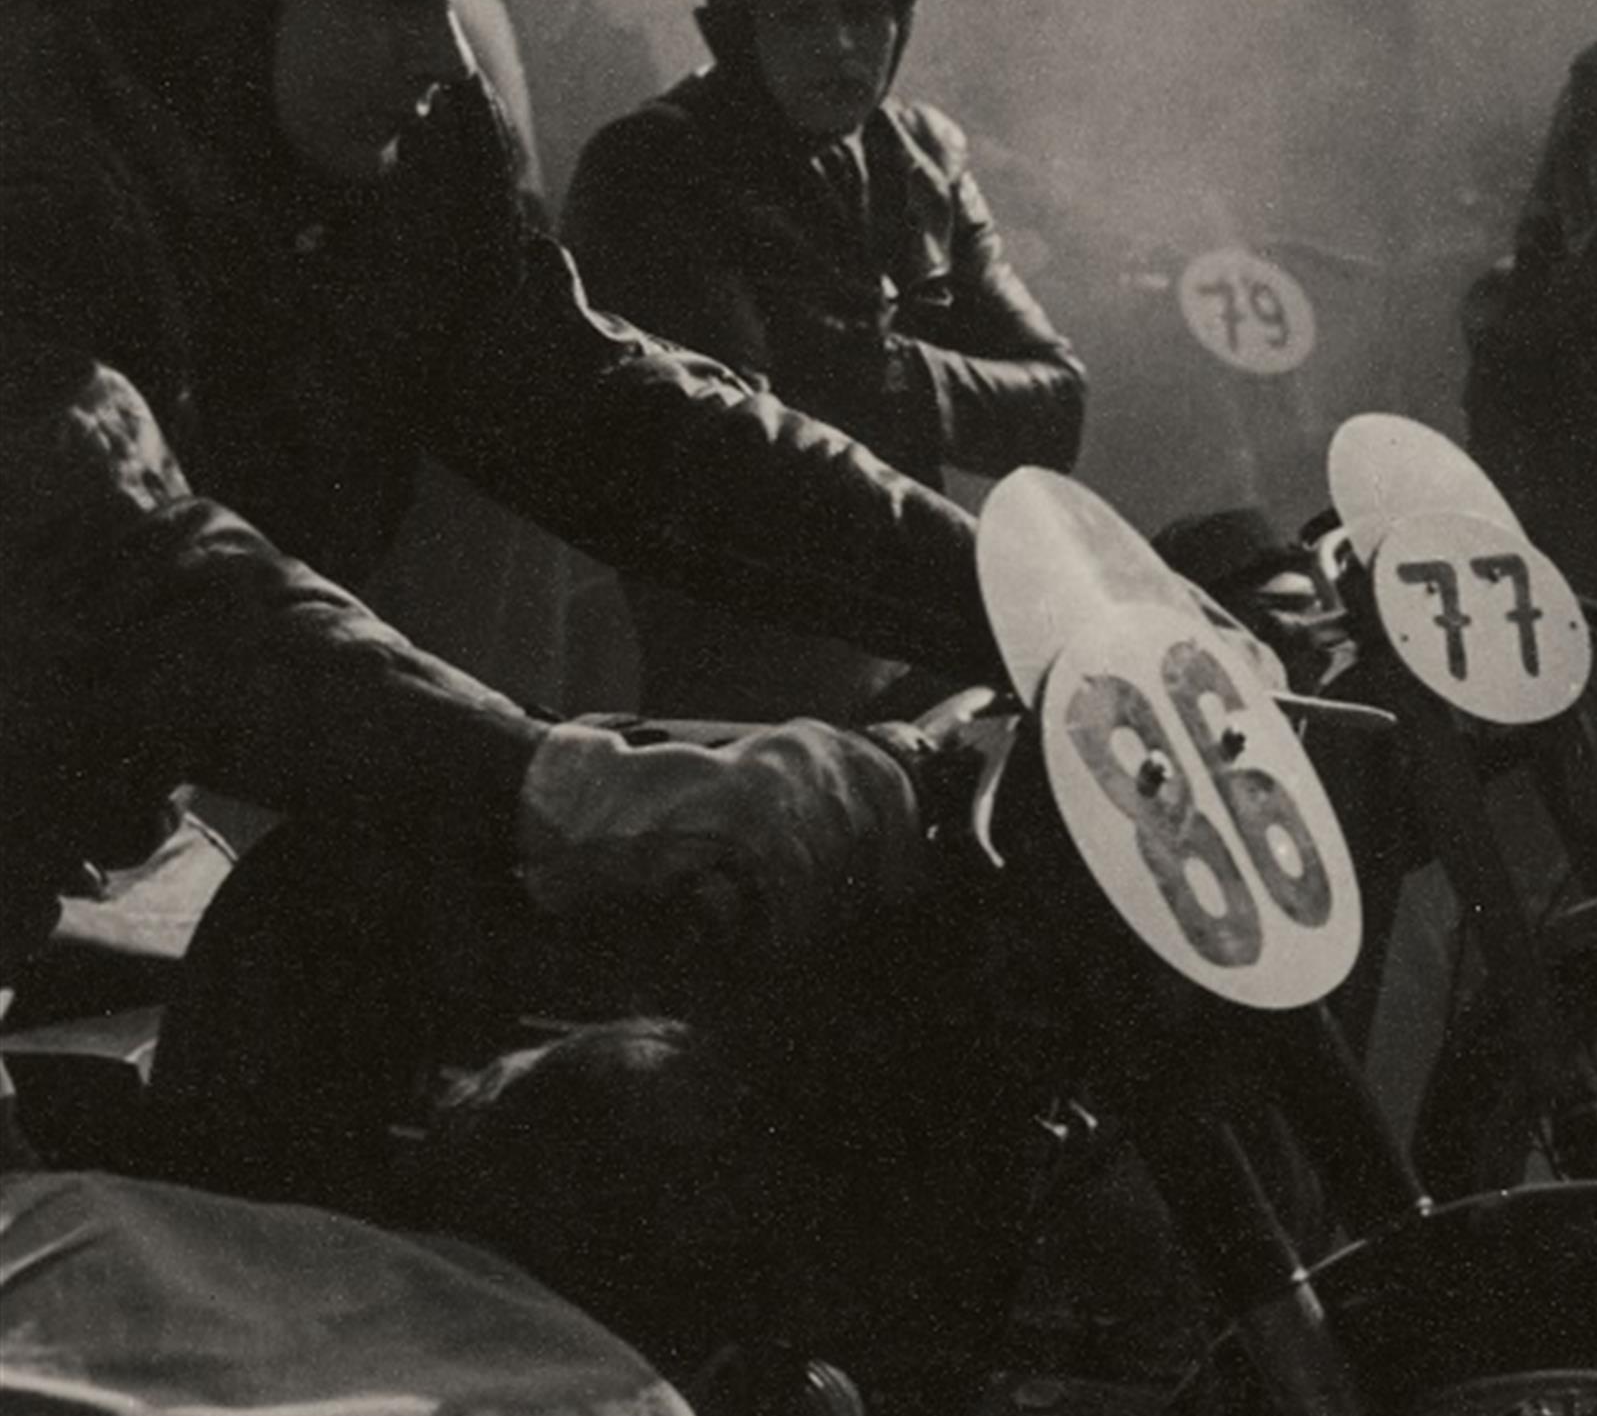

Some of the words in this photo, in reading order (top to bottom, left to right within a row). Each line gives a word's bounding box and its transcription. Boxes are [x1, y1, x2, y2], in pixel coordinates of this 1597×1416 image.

[1199, 280, 1292, 352] 79
[1397, 552, 1541, 681] 77
[1066, 638, 1334, 969] 86
